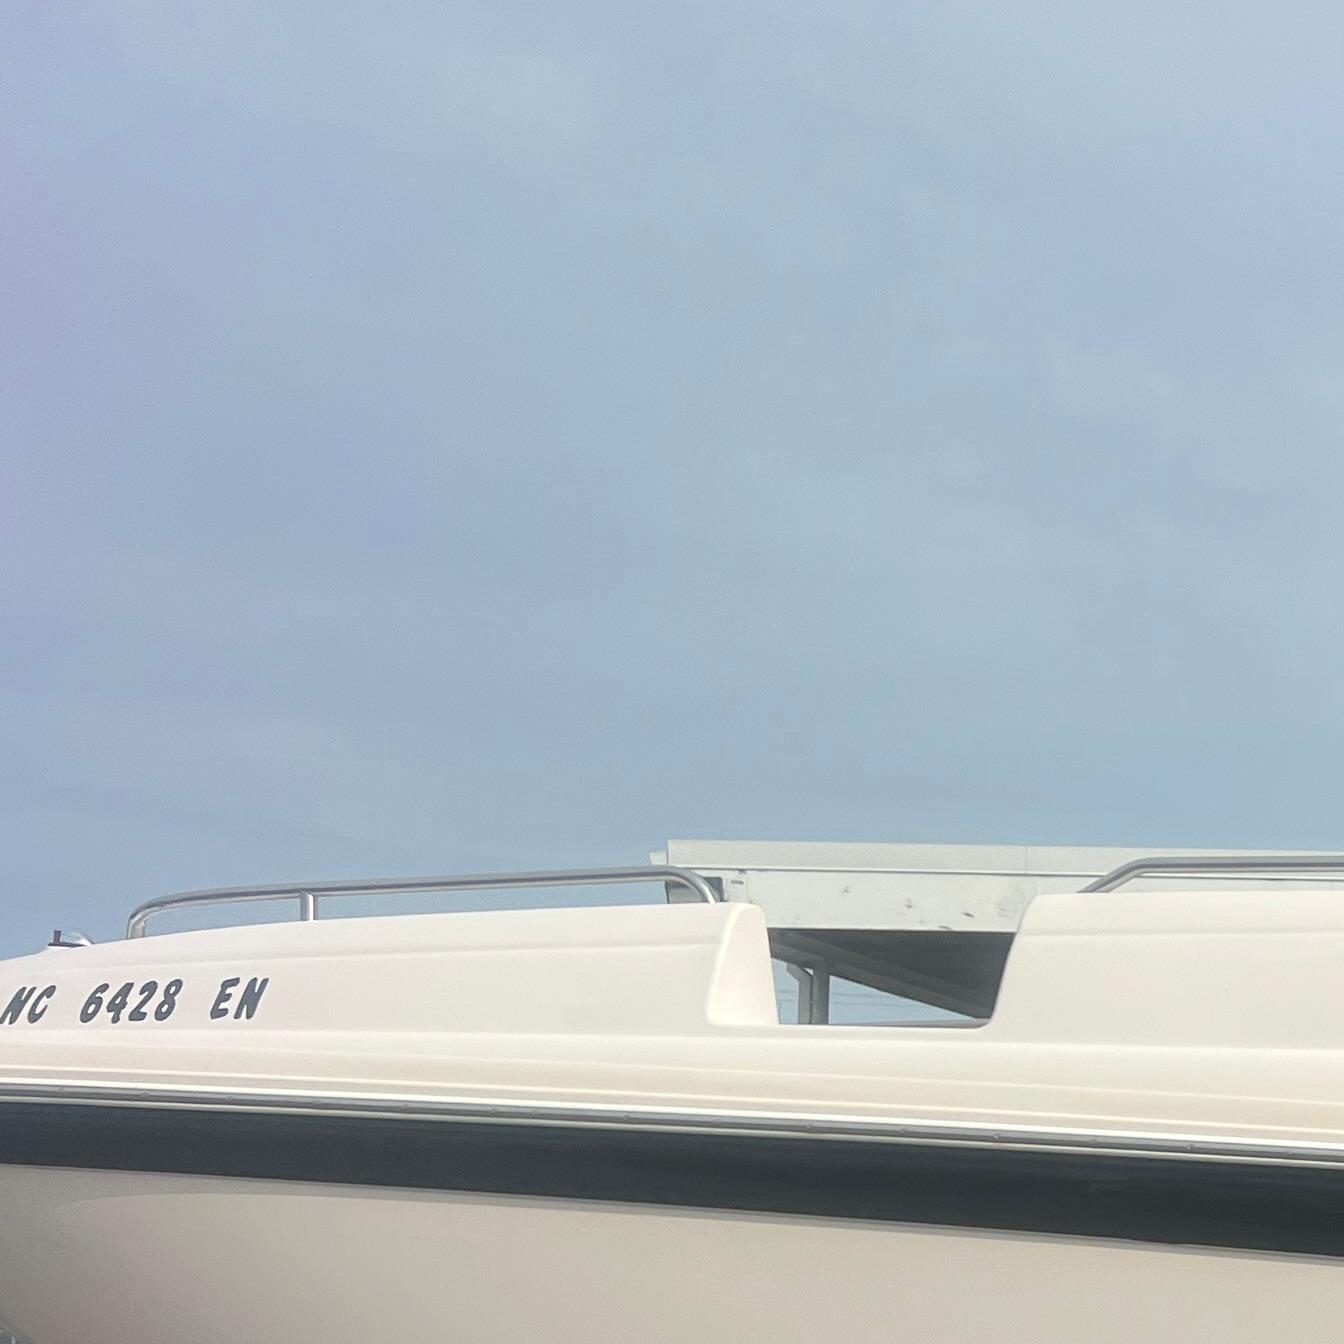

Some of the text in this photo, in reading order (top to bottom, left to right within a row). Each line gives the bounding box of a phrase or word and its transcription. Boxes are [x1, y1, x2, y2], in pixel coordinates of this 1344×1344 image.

[0, 977, 269, 1025] NC 6428 EN
